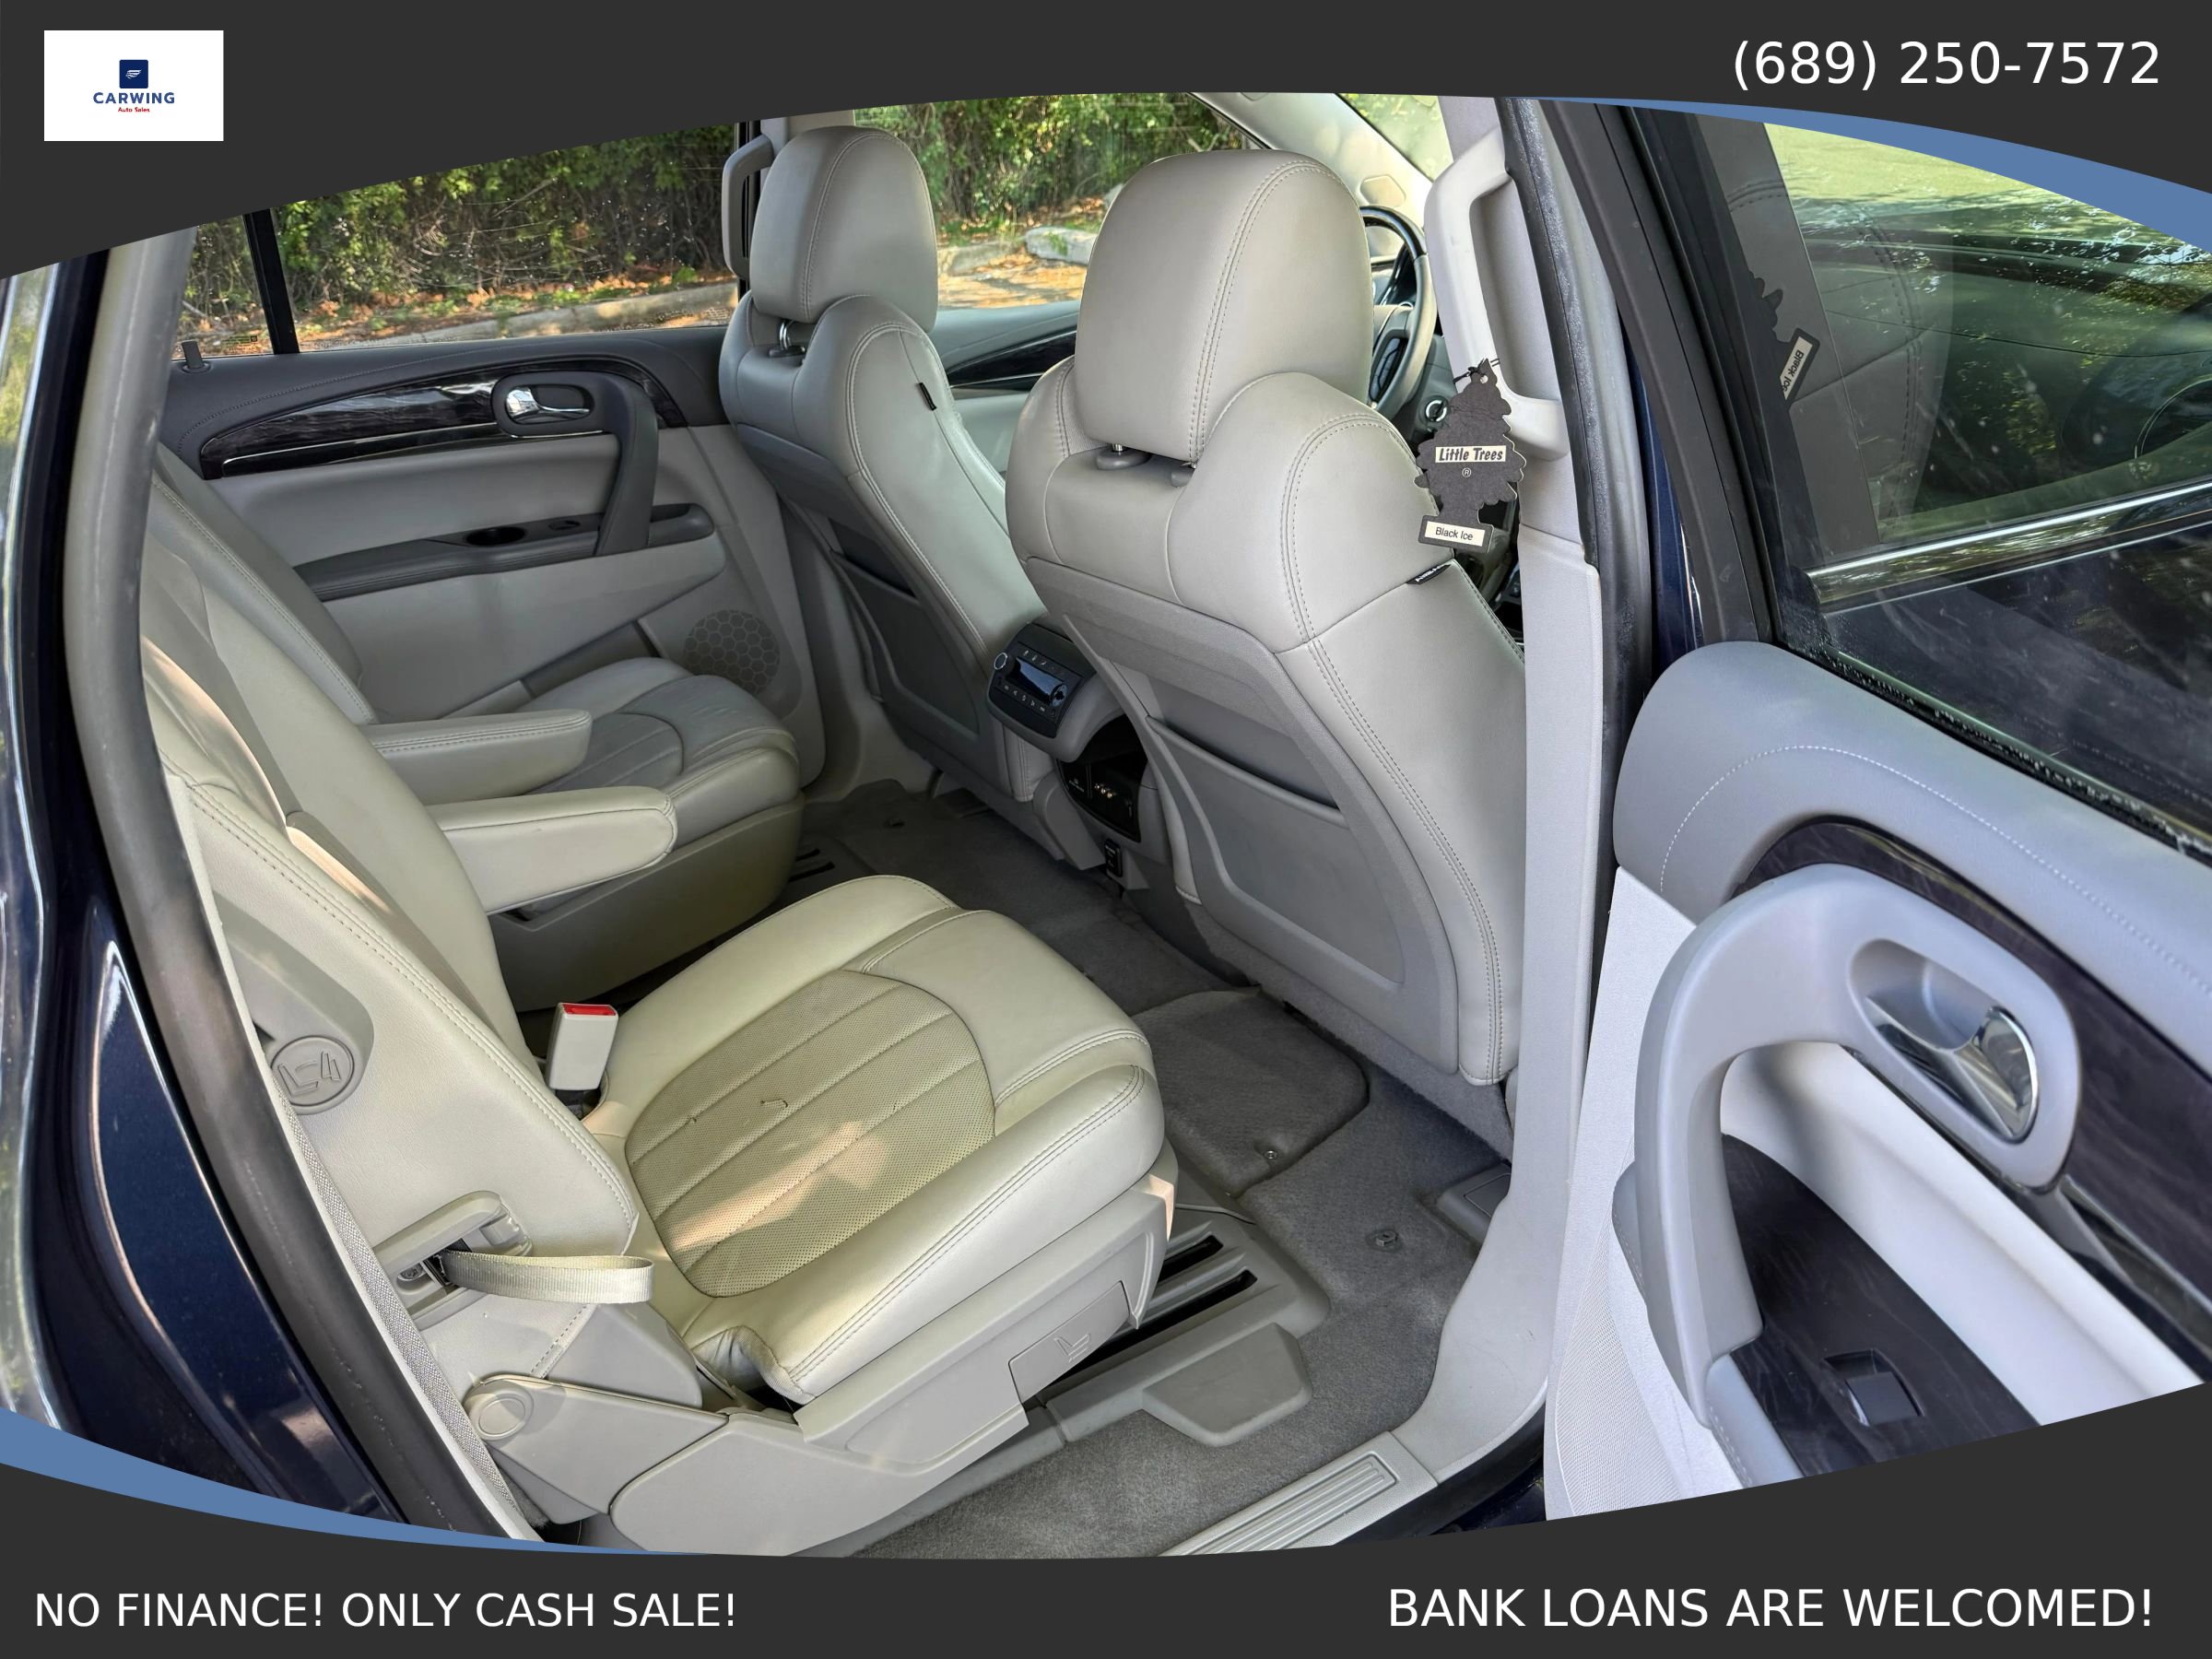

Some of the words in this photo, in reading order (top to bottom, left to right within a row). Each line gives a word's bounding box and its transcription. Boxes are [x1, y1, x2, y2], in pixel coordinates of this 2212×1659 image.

[1439, 448, 1469, 461] Little
[1473, 447, 1503, 461] Trees
[1435, 526, 1459, 538] Black
[1460, 530, 1474, 540] Ice
